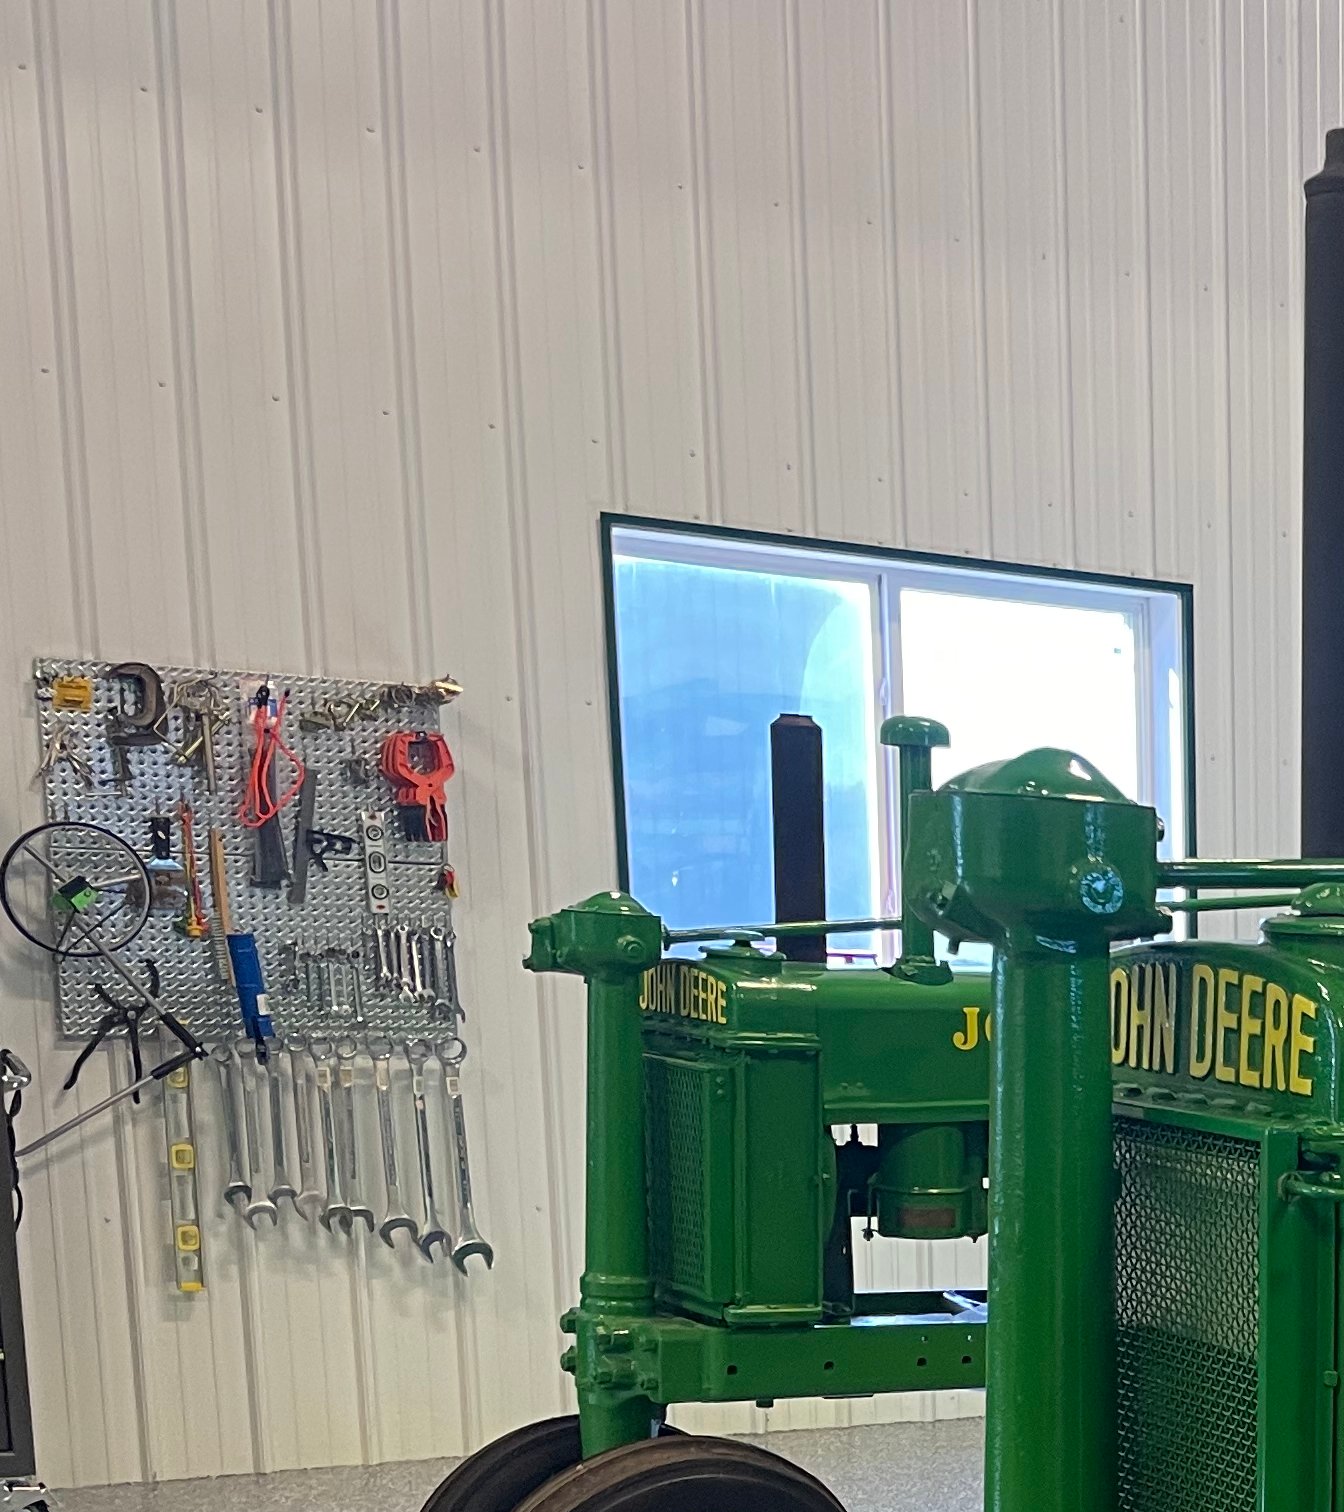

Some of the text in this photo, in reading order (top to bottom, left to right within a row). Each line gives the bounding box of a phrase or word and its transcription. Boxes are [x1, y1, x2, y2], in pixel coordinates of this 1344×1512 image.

[639, 962, 727, 1025] JOHN DEERE
[1110, 961, 1318, 1097] OHN DEERE
